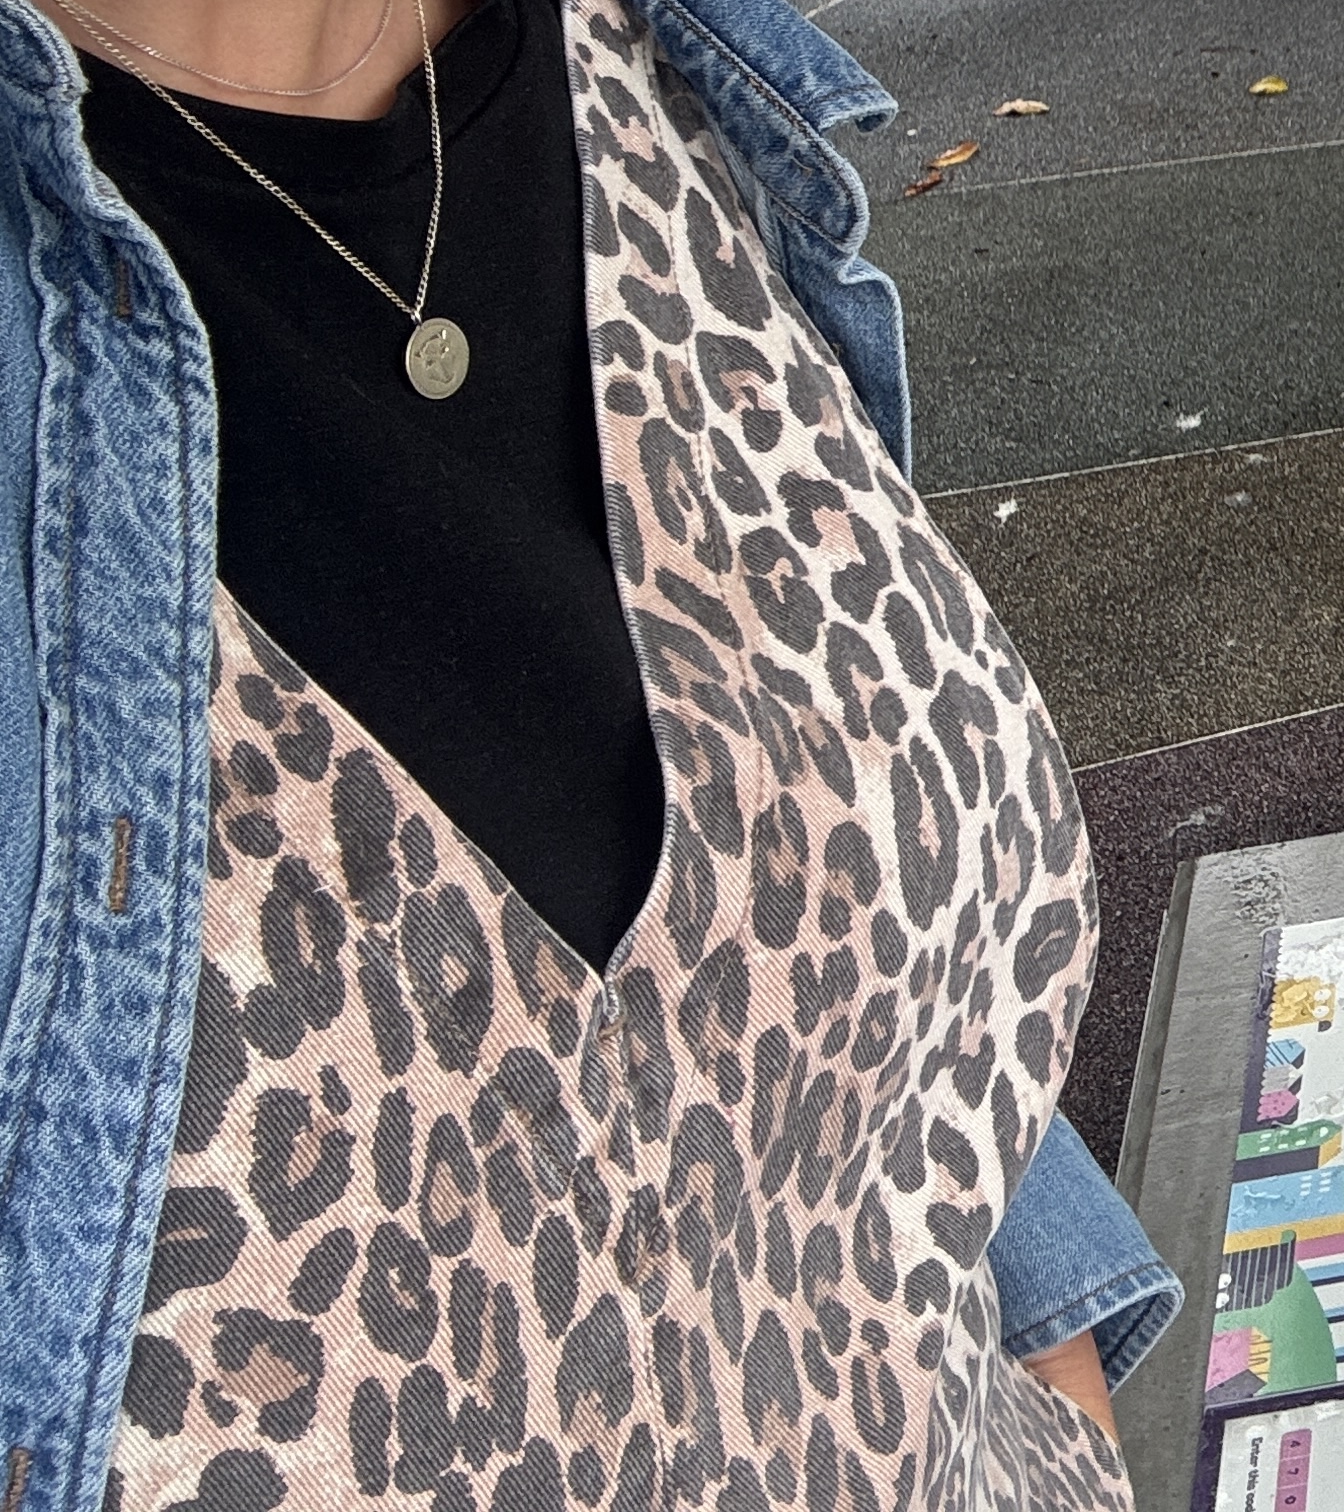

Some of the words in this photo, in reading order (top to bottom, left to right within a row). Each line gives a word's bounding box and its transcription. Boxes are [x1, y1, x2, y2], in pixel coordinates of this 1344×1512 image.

[1250, 1437, 1263, 1467] Enter
[1247, 1469, 1260, 1491] this
[1287, 1467, 1299, 1475] 7
